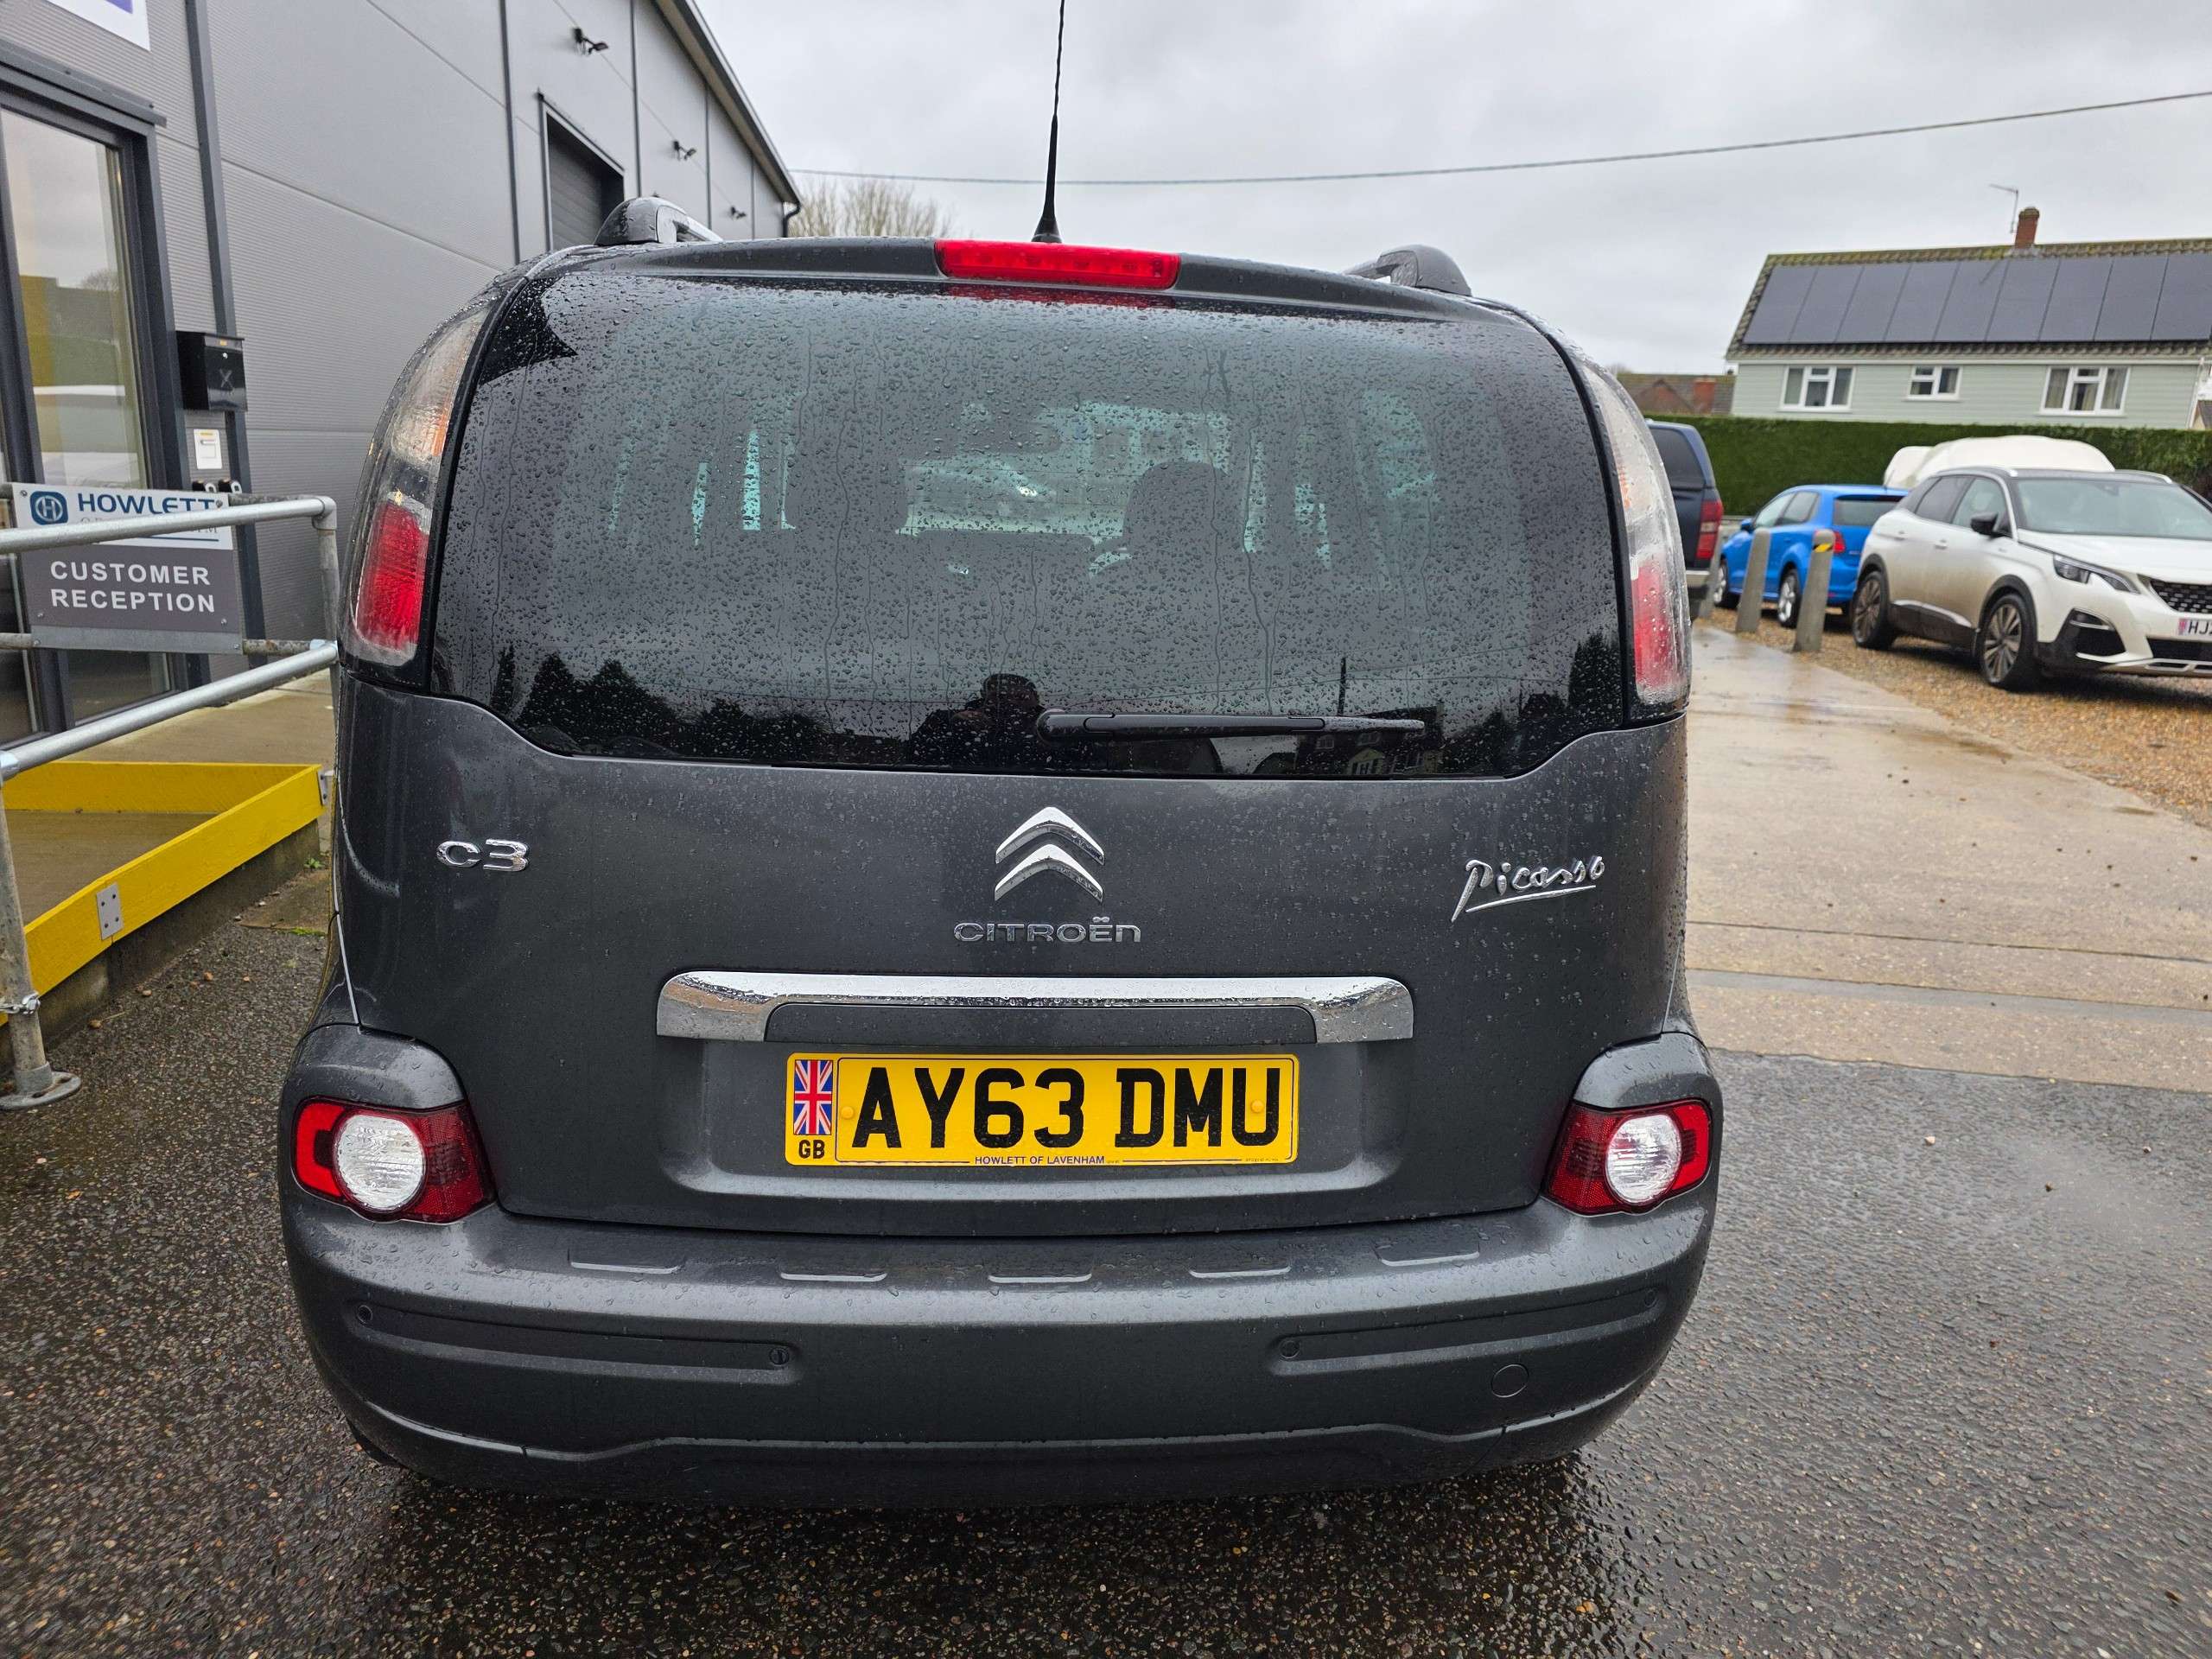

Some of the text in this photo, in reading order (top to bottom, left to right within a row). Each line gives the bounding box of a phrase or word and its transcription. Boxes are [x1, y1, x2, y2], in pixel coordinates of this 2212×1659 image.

[50, 561, 211, 585] CUSTOMER
[50, 588, 215, 613] RECEPTION
[2188, 619, 2212, 635] HJ
[436, 838, 529, 872] C3
[1451, 855, 1606, 923] Picasso
[851, 1066, 1281, 1148] AY63 DMU
[798, 1139, 825, 1159] GB
[975, 1155, 1027, 1165] HOWLETT
[1029, 1155, 1044, 1165] OF
[1046, 1155, 1105, 1165] LAVENHAM
